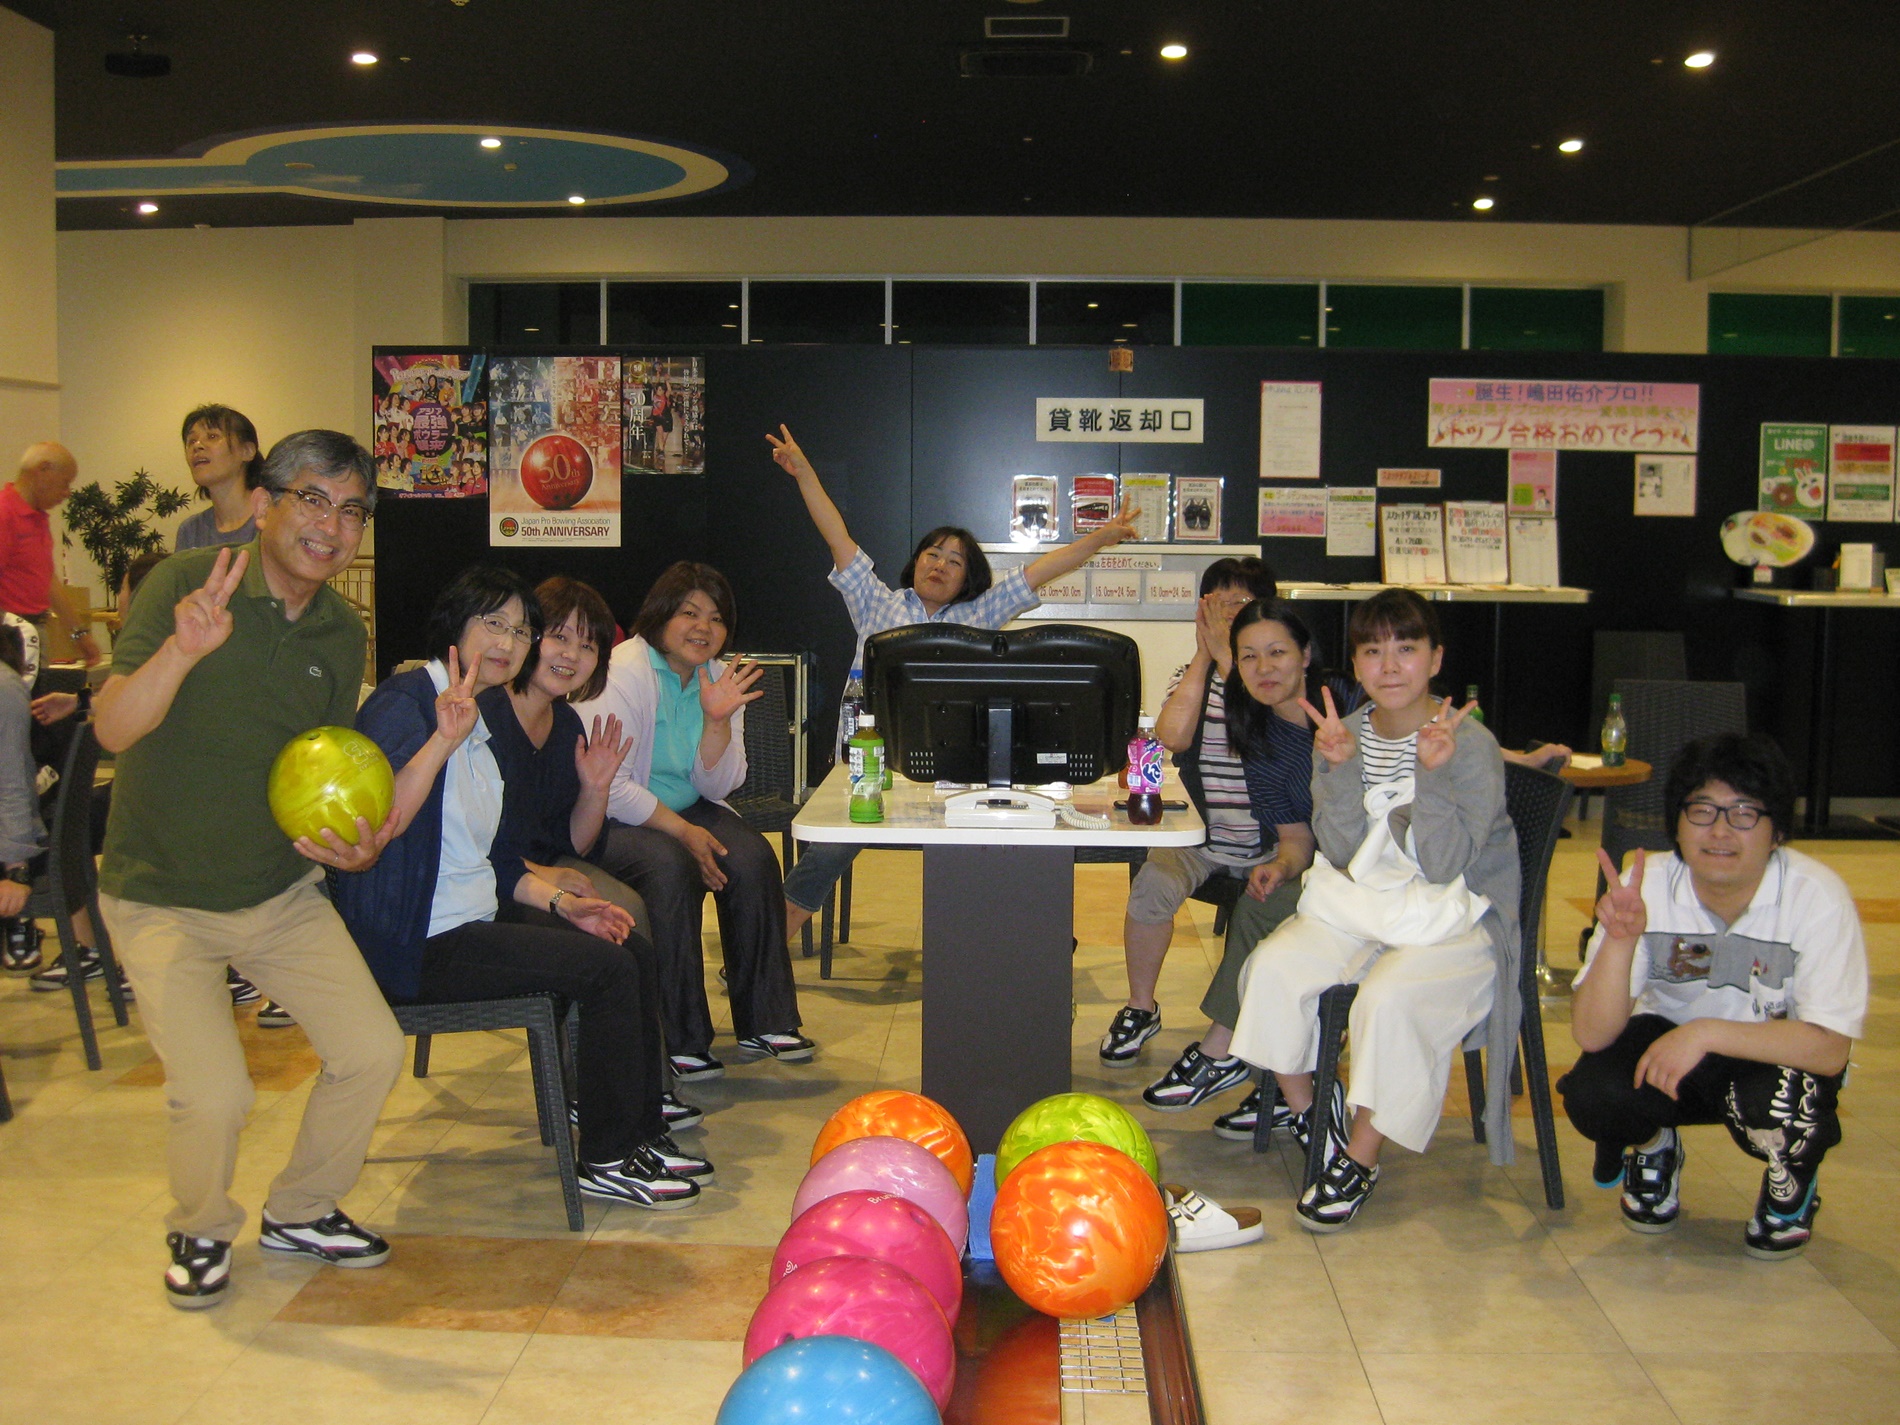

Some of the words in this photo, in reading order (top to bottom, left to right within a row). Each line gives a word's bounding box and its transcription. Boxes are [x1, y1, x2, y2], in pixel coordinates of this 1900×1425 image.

[1048, 408, 1192, 432] 貸靴返却口
[521, 517, 539, 526] Japan
[541, 517, 550, 525] Pro
[552, 517, 576, 526] Bowling
[577, 517, 611, 525] Association
[521, 527, 540, 537] 50th
[543, 526, 610, 537] ANNIVERSARY
